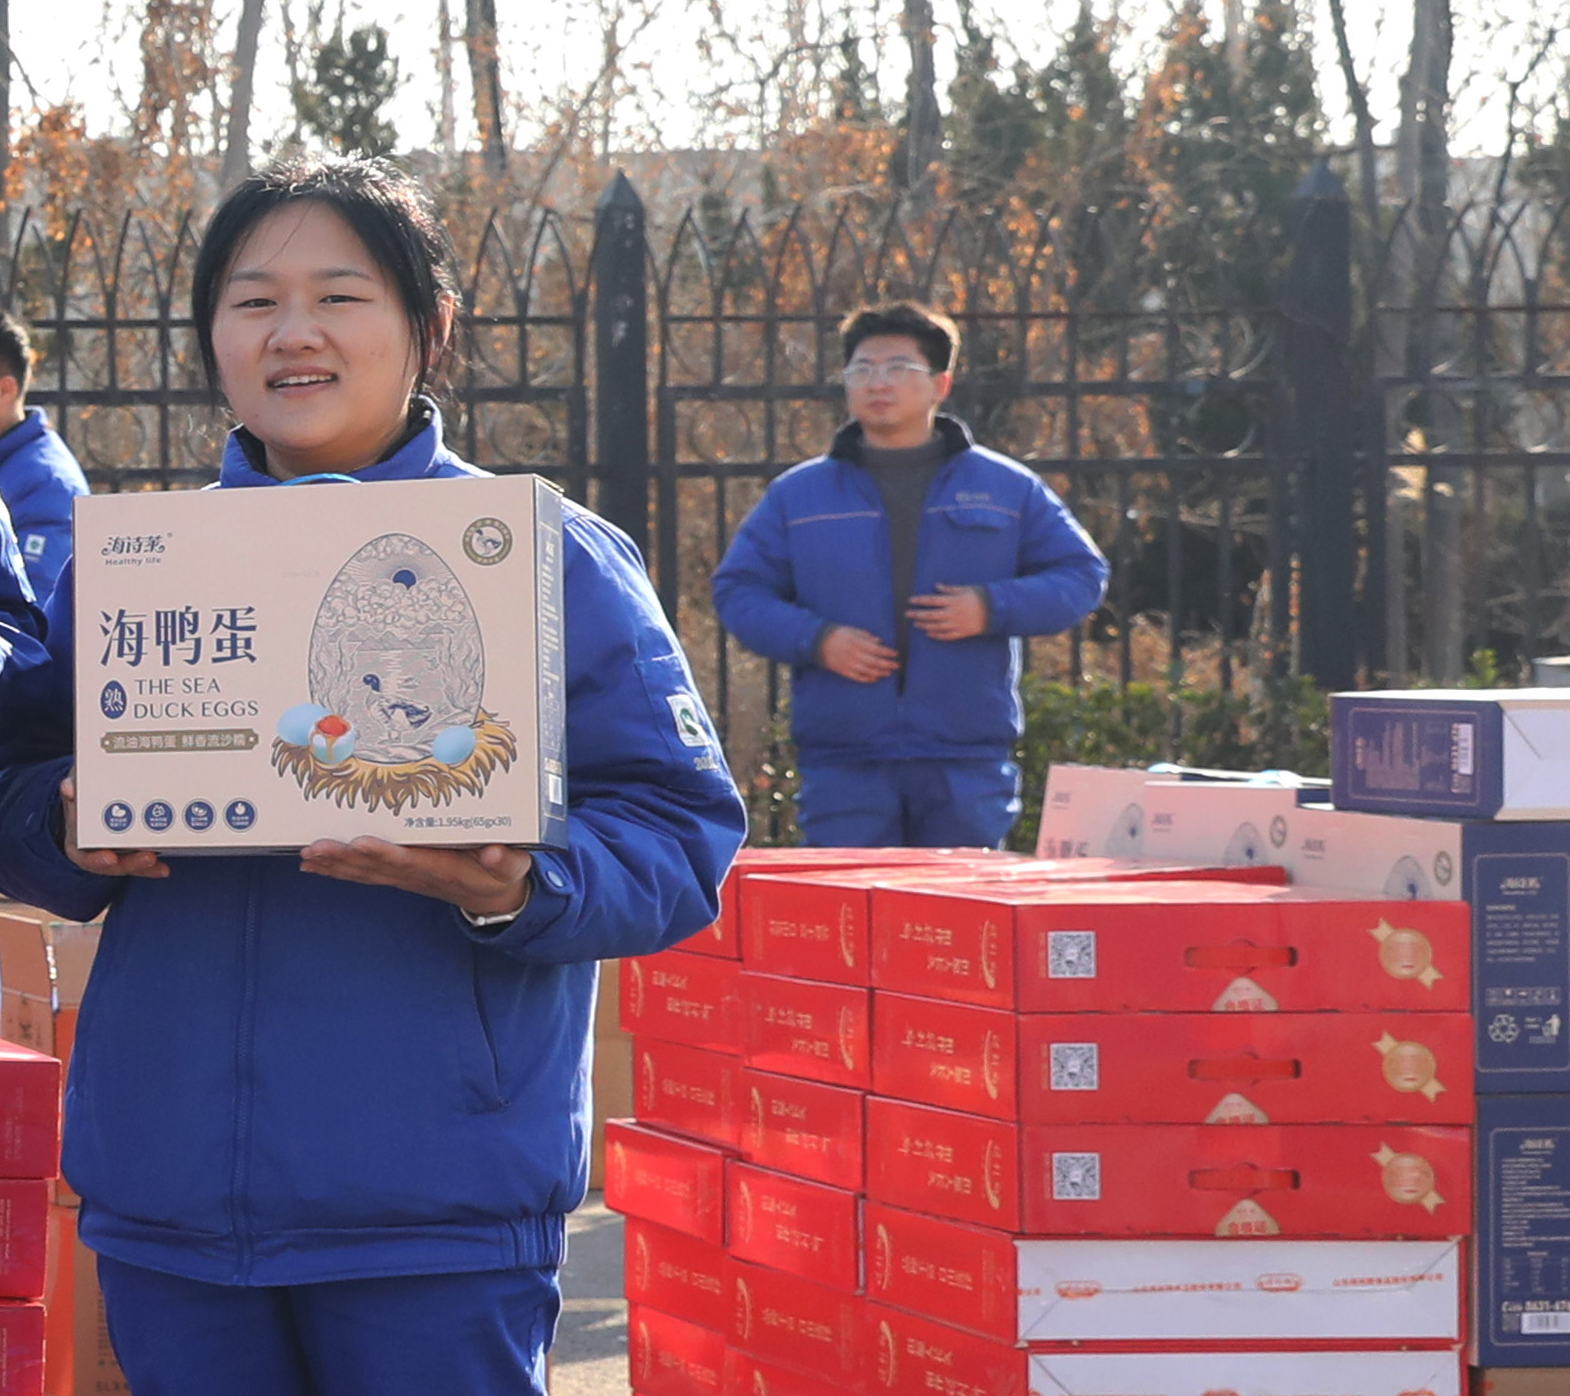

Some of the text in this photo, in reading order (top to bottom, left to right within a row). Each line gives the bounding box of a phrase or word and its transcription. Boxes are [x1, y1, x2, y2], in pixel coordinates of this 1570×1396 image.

[105, 556, 162, 567] Healthy life
[100, 606, 258, 668] 海鸭蛋
[135, 679, 221, 695] THE SEA
[134, 701, 259, 718] DUCK EGGS
